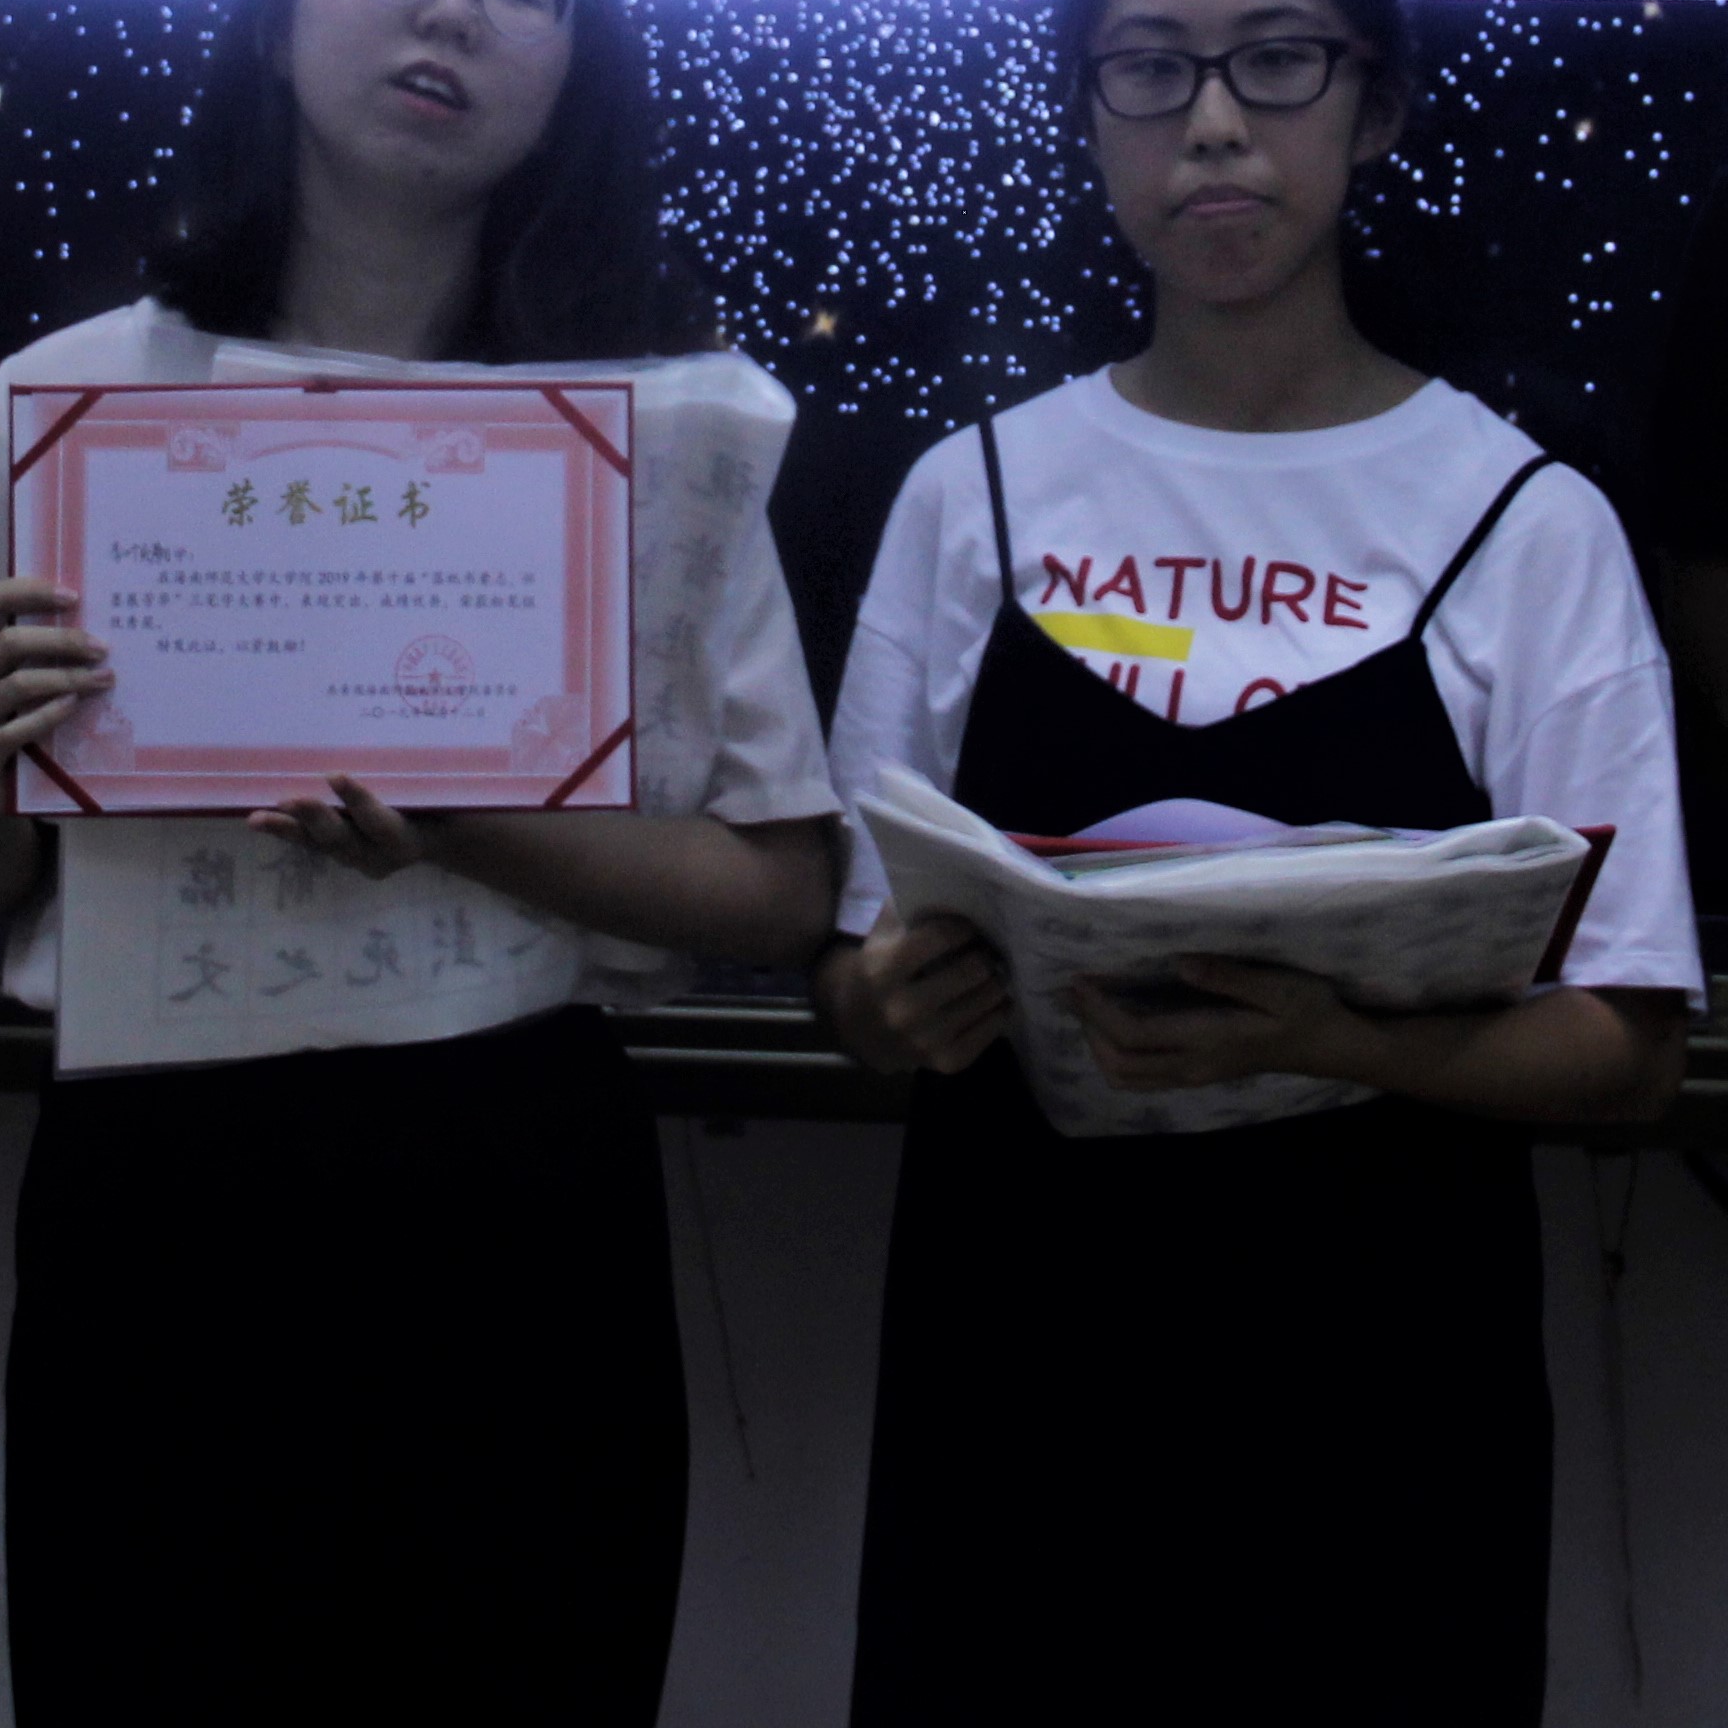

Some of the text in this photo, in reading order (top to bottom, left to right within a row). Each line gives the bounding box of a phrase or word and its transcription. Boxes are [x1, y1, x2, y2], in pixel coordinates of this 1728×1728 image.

[220, 477, 434, 529] 荣誉证书
[1040, 552, 1372, 630] NATURE
